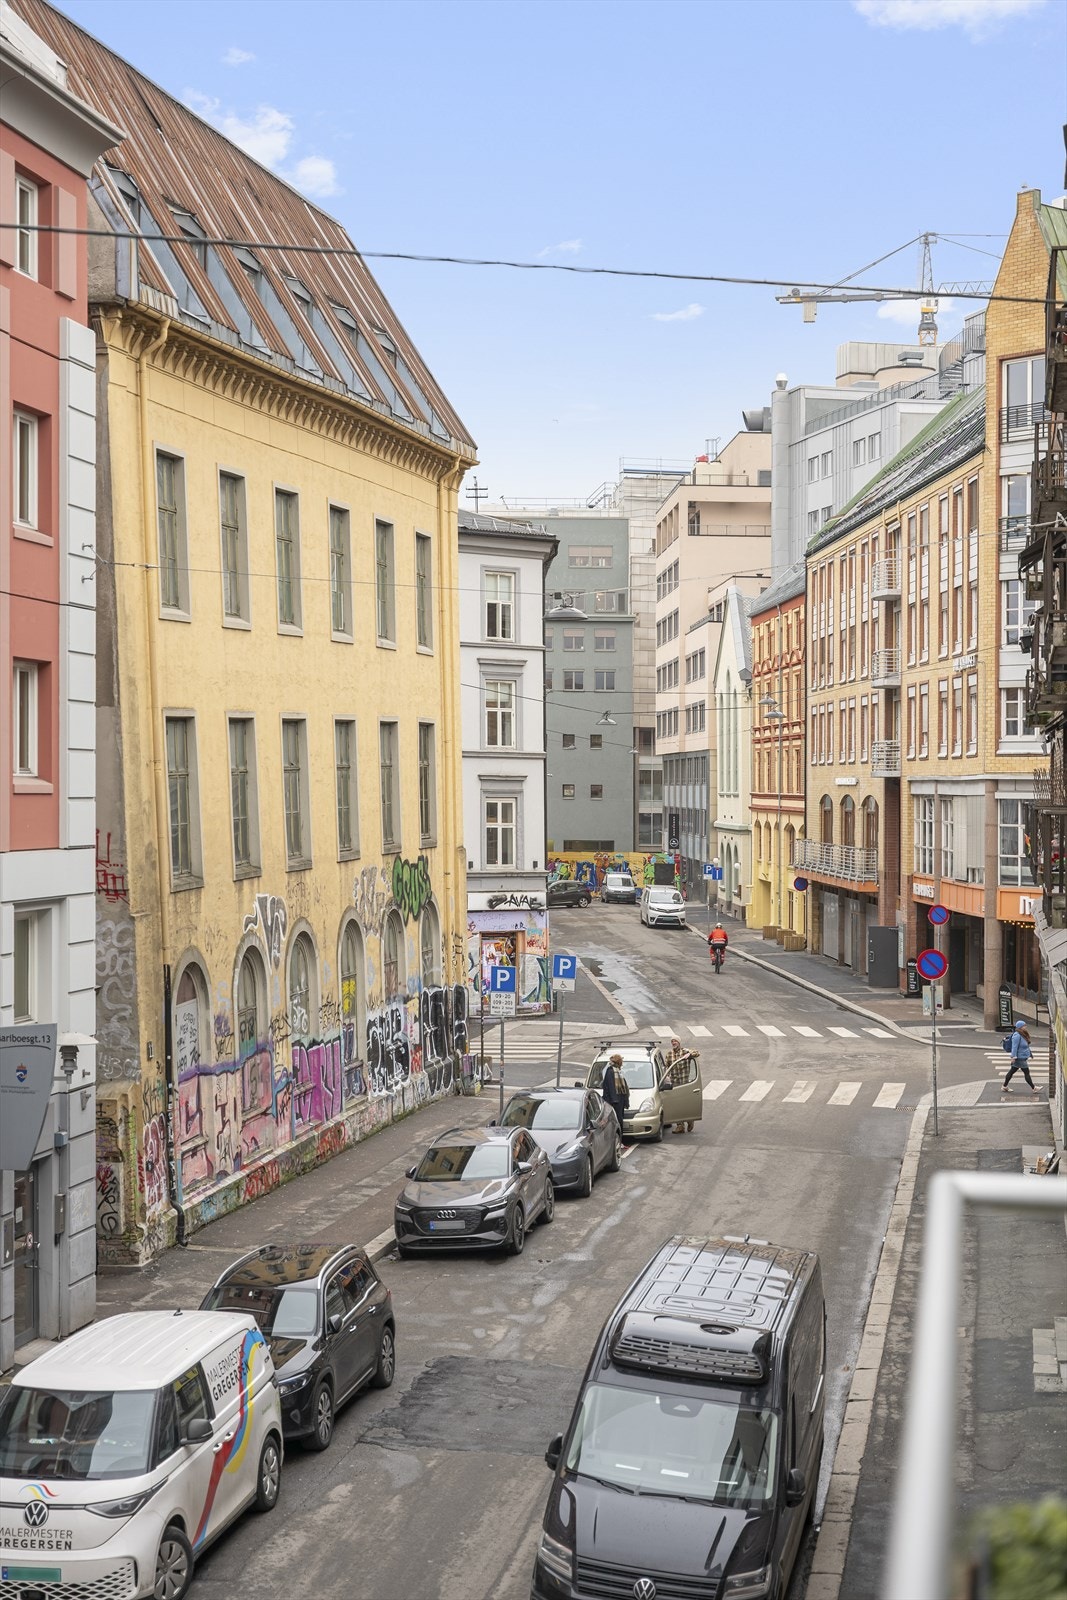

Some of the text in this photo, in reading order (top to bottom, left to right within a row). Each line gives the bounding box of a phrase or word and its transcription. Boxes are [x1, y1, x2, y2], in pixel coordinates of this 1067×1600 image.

[559, 958, 572, 975] P
[496, 969, 510, 989] P
[0, 1538, 73, 1550] REGERSEN
